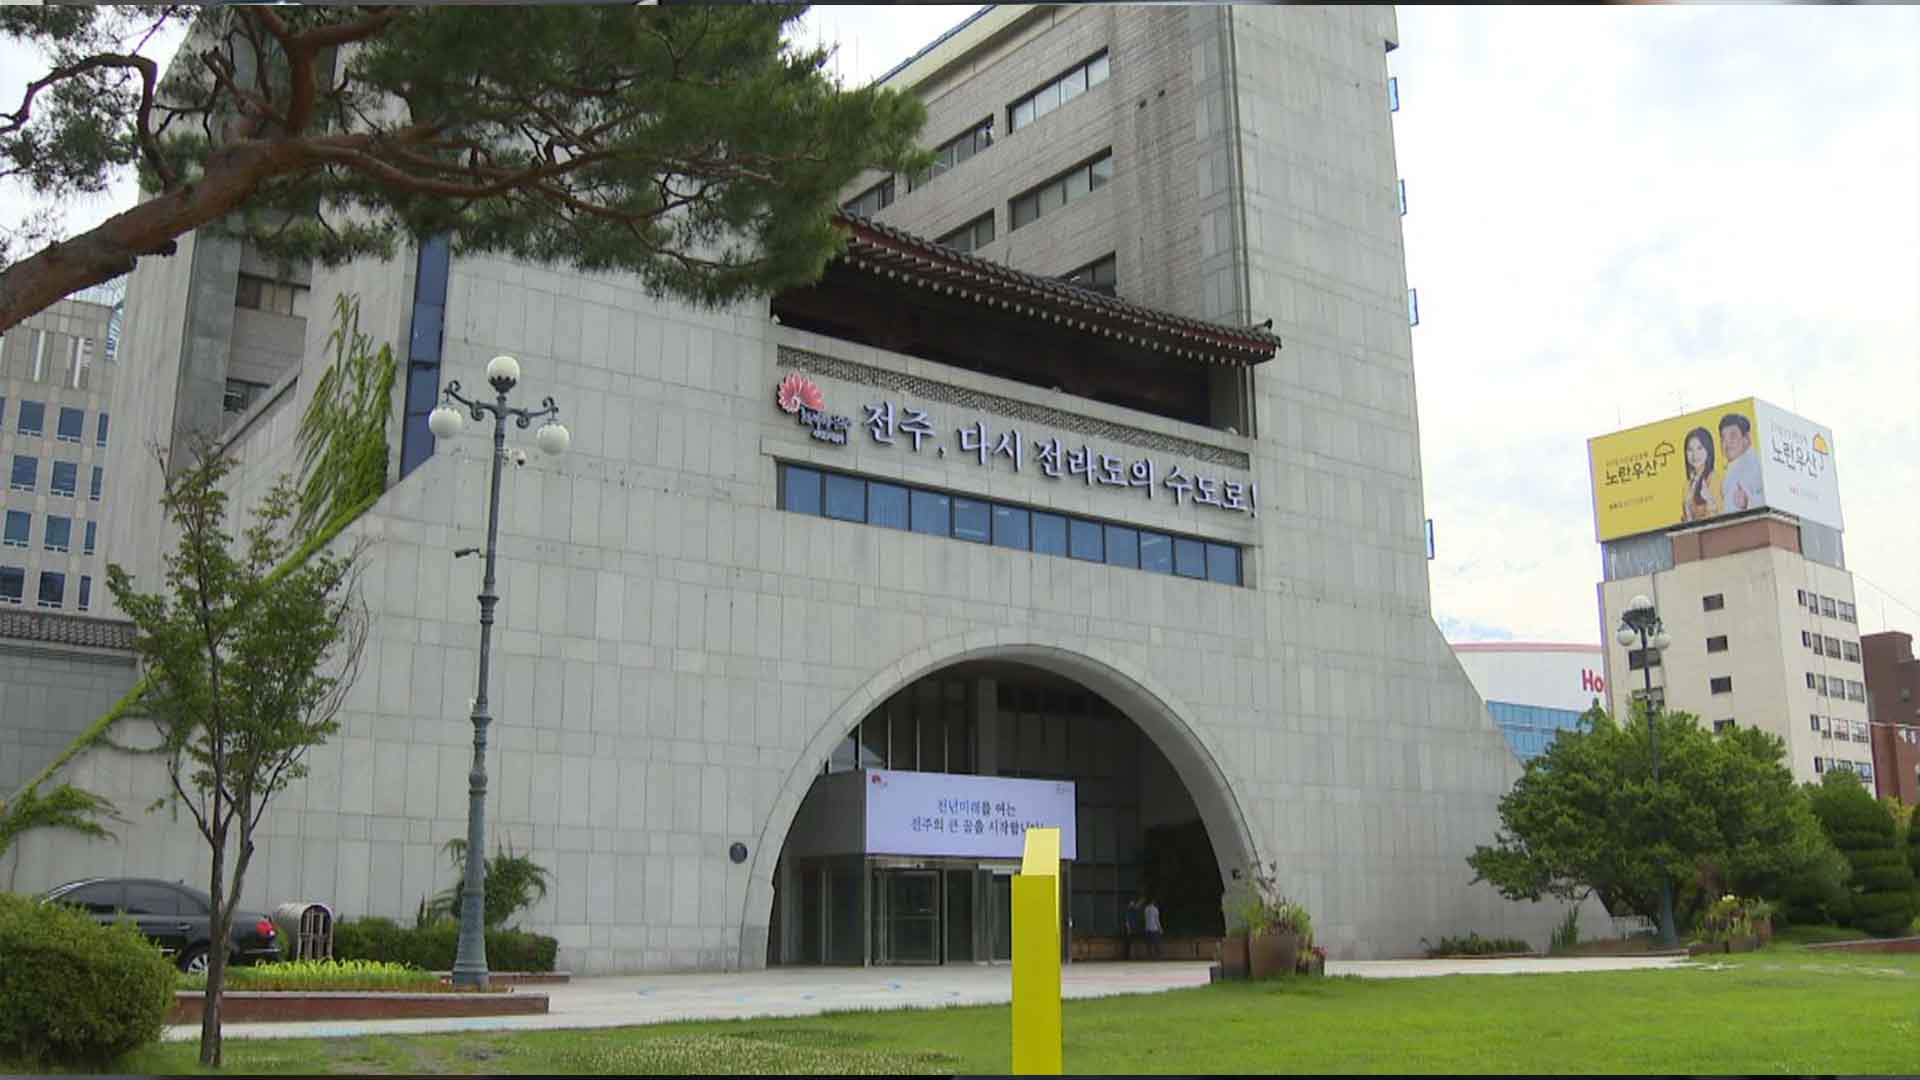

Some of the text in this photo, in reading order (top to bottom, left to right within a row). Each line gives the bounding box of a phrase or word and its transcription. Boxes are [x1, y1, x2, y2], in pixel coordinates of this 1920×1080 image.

[862, 400, 946, 458] 전주,
[957, 421, 1023, 473] 다시
[1034, 437, 1156, 500] 전라도의
[1163, 464, 1258, 519] 수도로!
[1605, 459, 1657, 487] 노란우산
[1772, 434, 1818, 480] 노란우산
[1582, 667, 1606, 693] Ho
